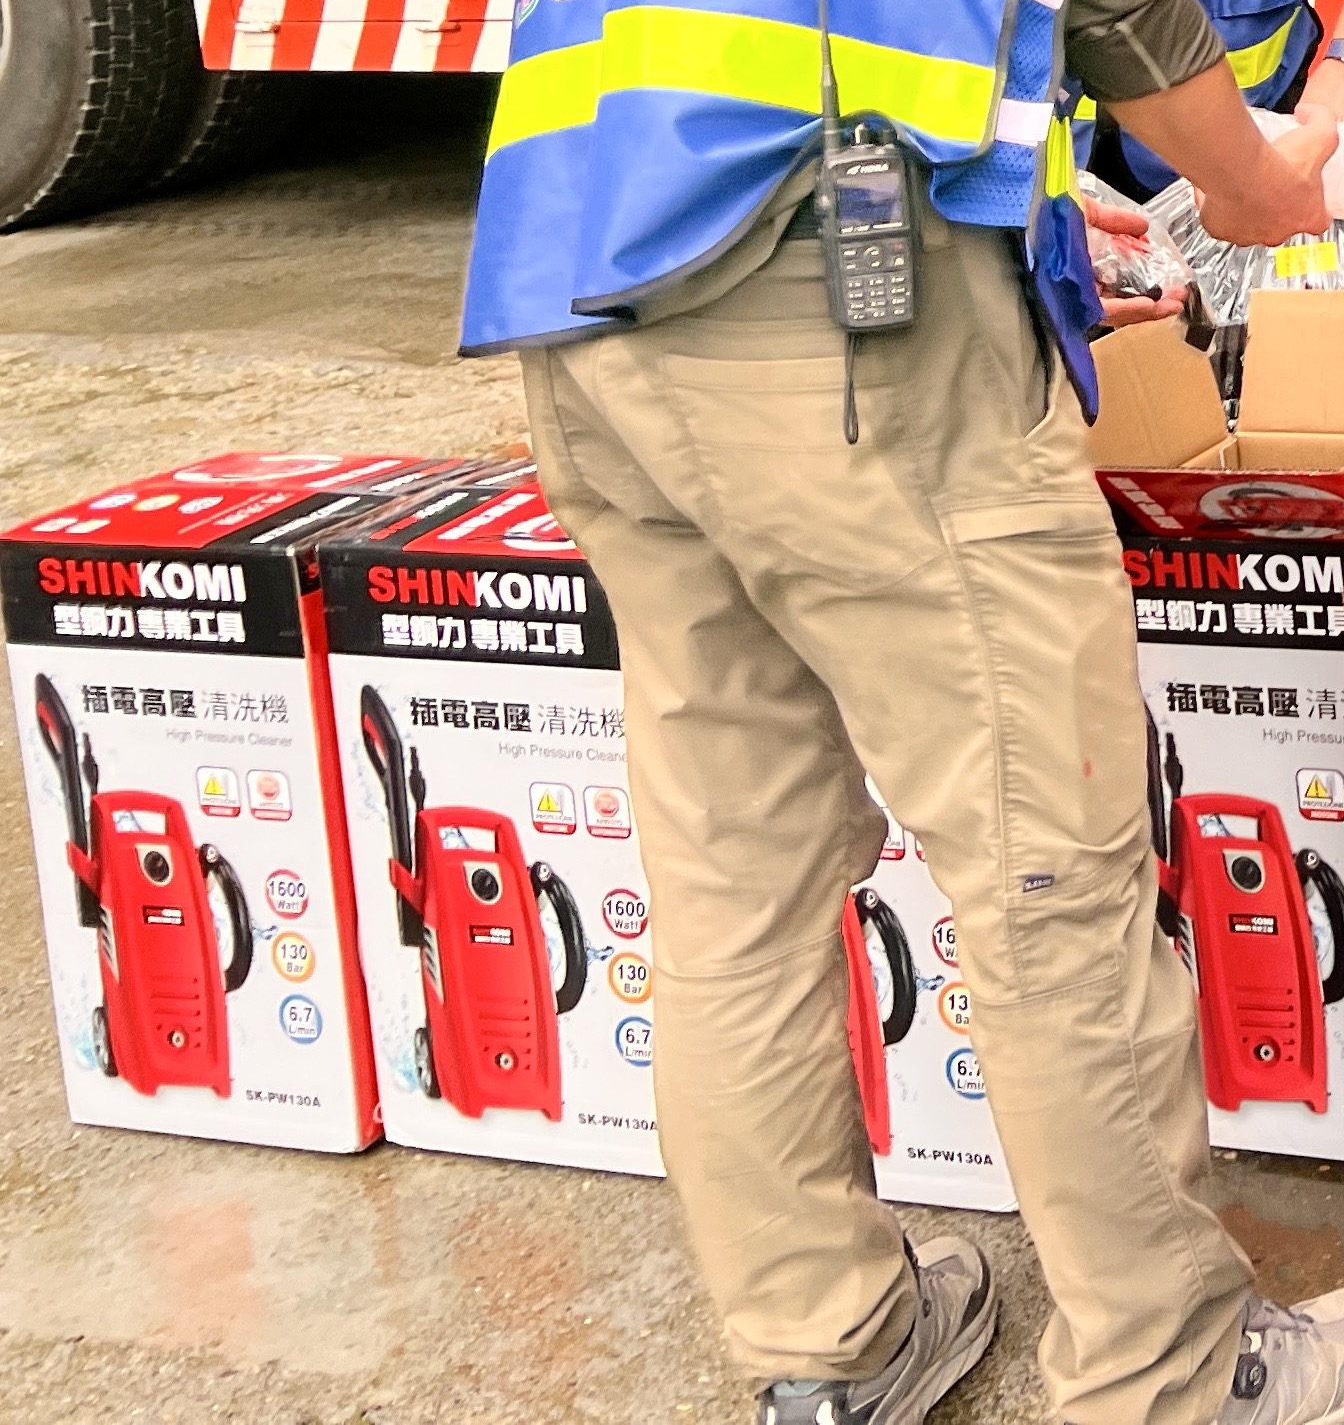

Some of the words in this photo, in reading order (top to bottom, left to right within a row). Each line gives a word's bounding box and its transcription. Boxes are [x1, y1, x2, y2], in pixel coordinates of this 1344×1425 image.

[37, 557, 246, 602] SHINKOMI
[368, 565, 588, 614] SHINKOMI
[1135, 599, 1228, 634] 型鋼力
[82, 684, 197, 719] 插電高壓
[202, 690, 290, 724] 清洗機
[1166, 681, 1300, 718] 插電高壓
[410, 696, 533, 733] 插電高壓
[166, 728, 192, 744] High
[248, 732, 293, 748] Cleaner
[1262, 728, 1292, 745] High
[498, 742, 526, 759] High
[530, 744, 583, 761] Pressure
[268, 881, 307, 899] 1600
[606, 900, 646, 918] 1600
[613, 918, 640, 931] Watt
[935, 928, 956, 946] 16
[281, 943, 308, 961] 130
[286, 962, 304, 973] Bar
[616, 964, 647, 981] 130
[624, 983, 643, 995] Bar
[948, 994, 970, 1012] 13
[289, 1006, 313, 1023] 6.7
[955, 1014, 970, 1025] Ba
[625, 1028, 651, 1045] 6.7
[245, 1089, 321, 1108] SK-PW130A
[907, 1147, 993, 1166] SK-PW130A
